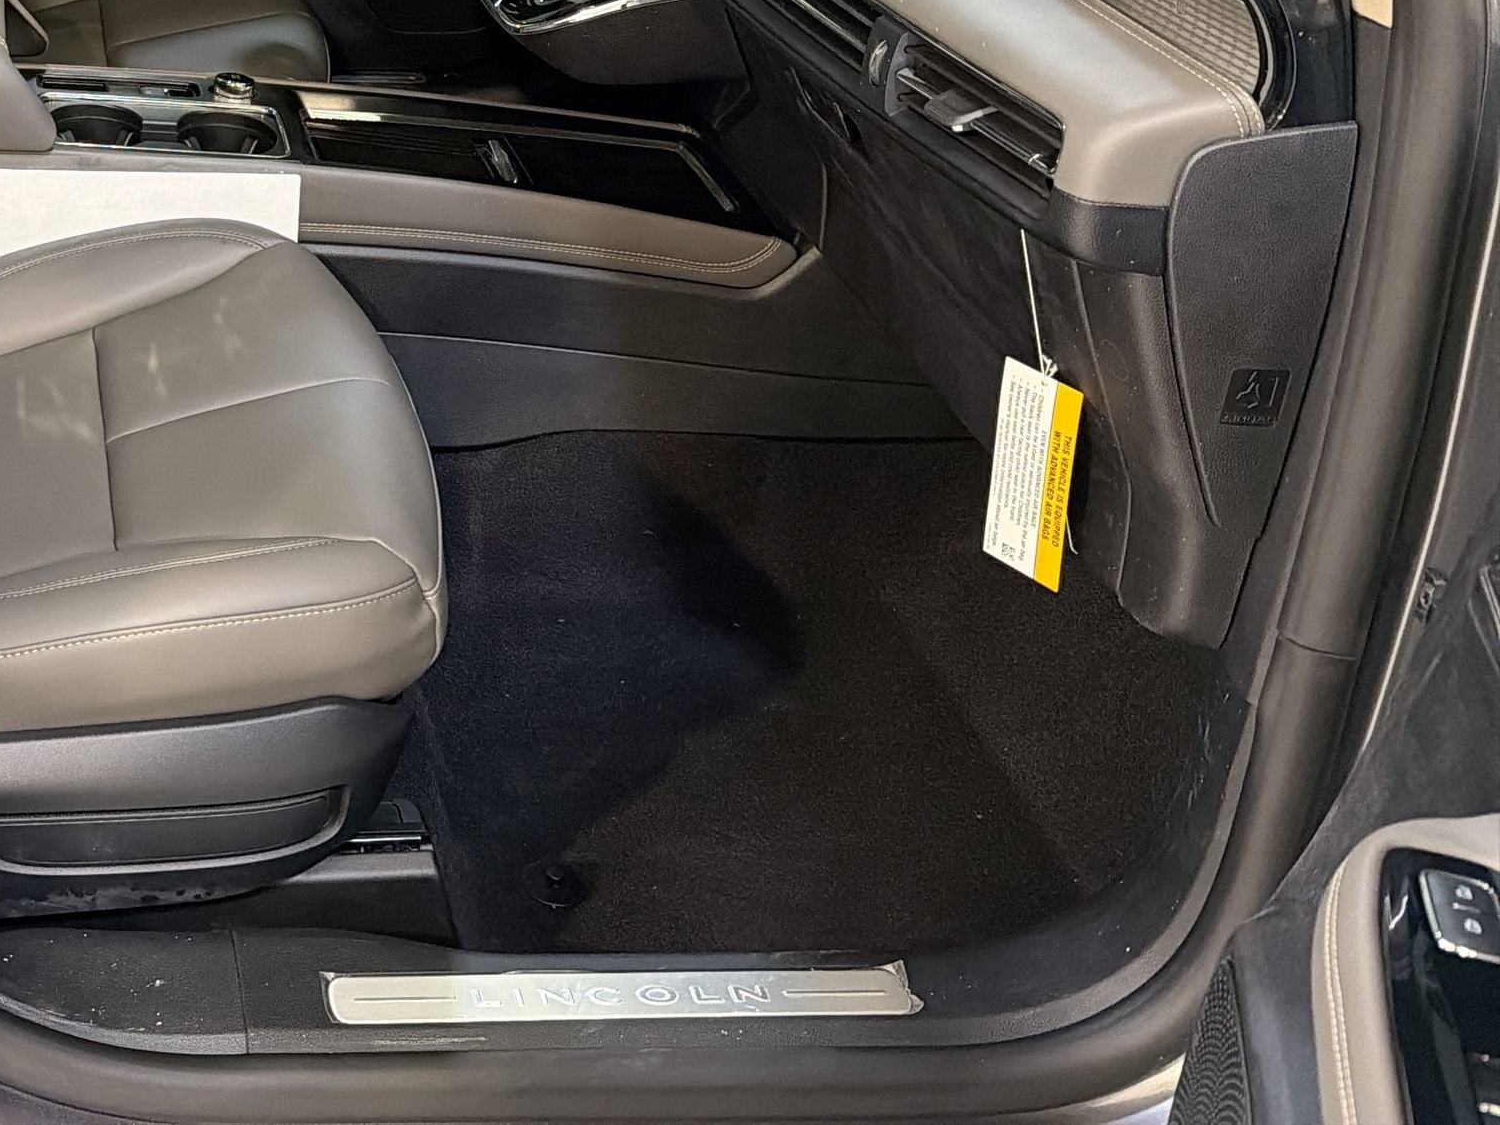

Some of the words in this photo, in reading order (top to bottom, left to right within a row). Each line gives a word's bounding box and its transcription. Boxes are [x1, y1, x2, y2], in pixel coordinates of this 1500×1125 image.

[1051, 429, 1061, 454] WITH
[1062, 434, 1071, 456] THIS
[1045, 454, 1058, 500] ADVANCED
[1057, 456, 1069, 494] VEHICLE
[1043, 500, 1052, 517] AIR
[1055, 493, 1064, 504] IS
[1040, 516, 1050, 541] BAGS
[1050, 504, 1062, 548] EQUIPPED
[470, 983, 773, 1009] LINCOLN
